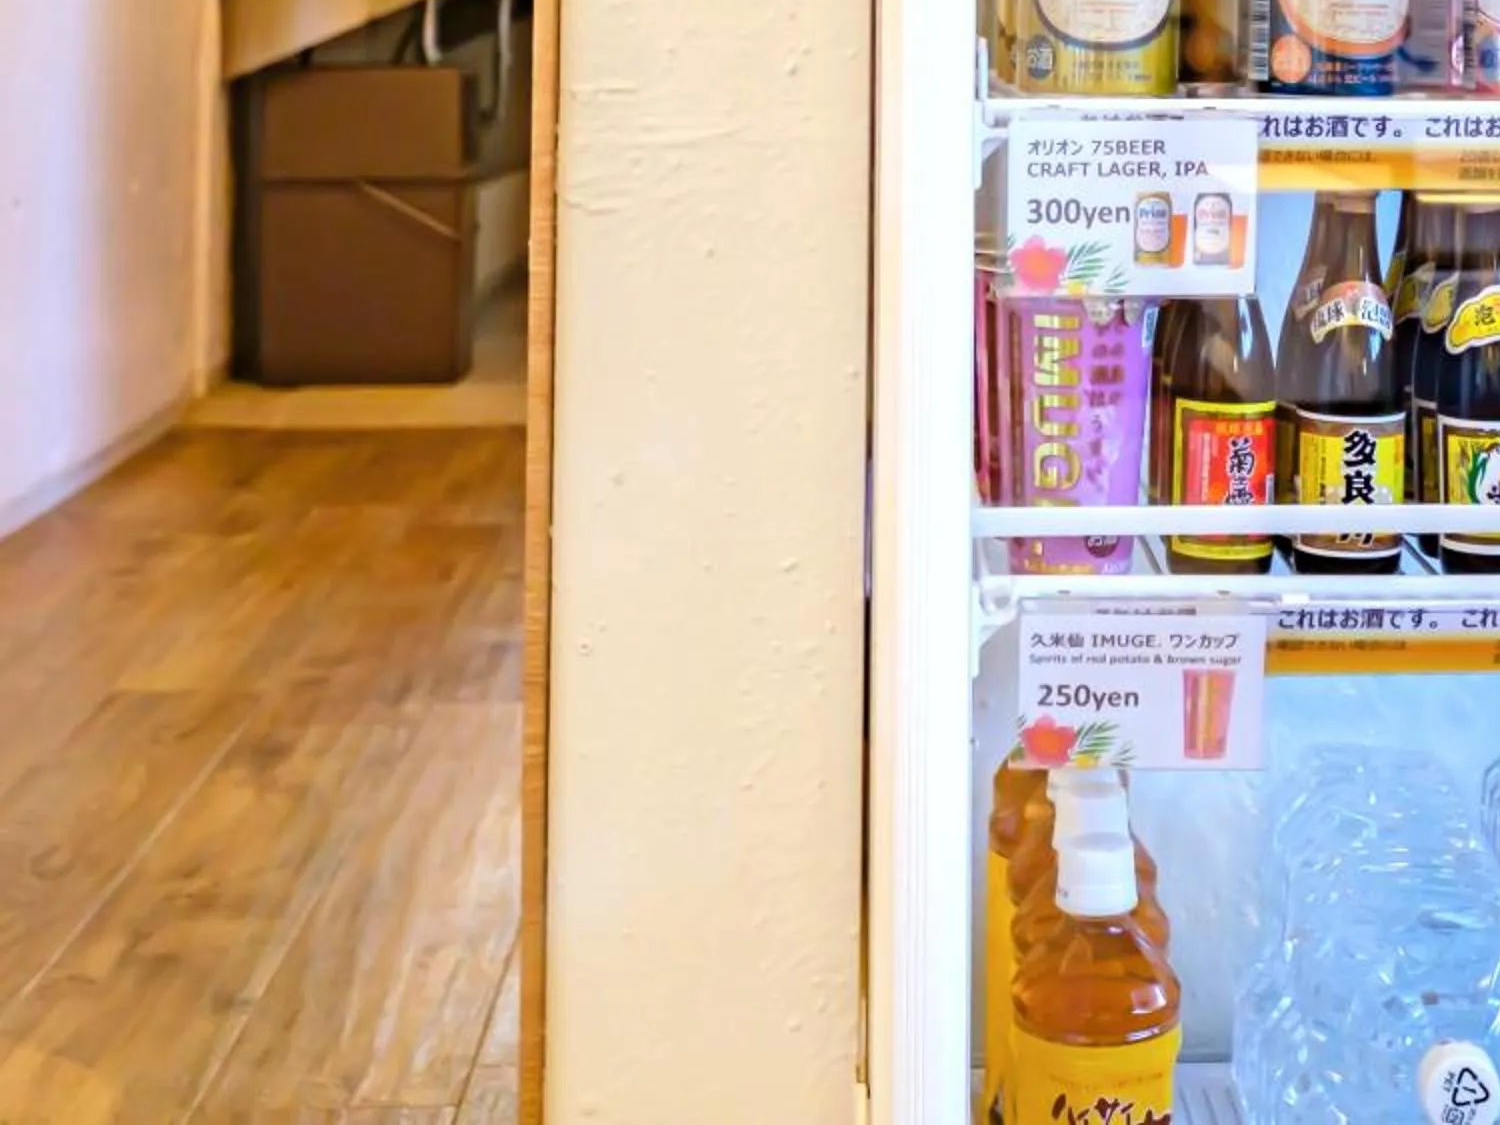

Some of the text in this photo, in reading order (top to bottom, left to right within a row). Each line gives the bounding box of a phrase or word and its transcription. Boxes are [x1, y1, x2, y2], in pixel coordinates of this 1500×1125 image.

[1027, 139, 1167, 156] オリオン 75BEER
[1027, 161, 1209, 180] CRAFT LAGER, IPA
[1026, 198, 1132, 228] 300yen
[1032, 314, 1084, 508] IMUG
[1277, 608, 1439, 630] これはお酒です。
[1030, 632, 1085, 649] 久米仙
[1169, 632, 1241, 649] ワンカップ
[1070, 653, 1084, 664] of
[1086, 653, 1107, 664] red
[1109, 653, 1150, 665] potato
[1152, 654, 1164, 664] &
[1166, 654, 1206, 665] brown
[1209, 656, 1242, 666] sugar
[1036, 684, 1140, 711] 250yen
